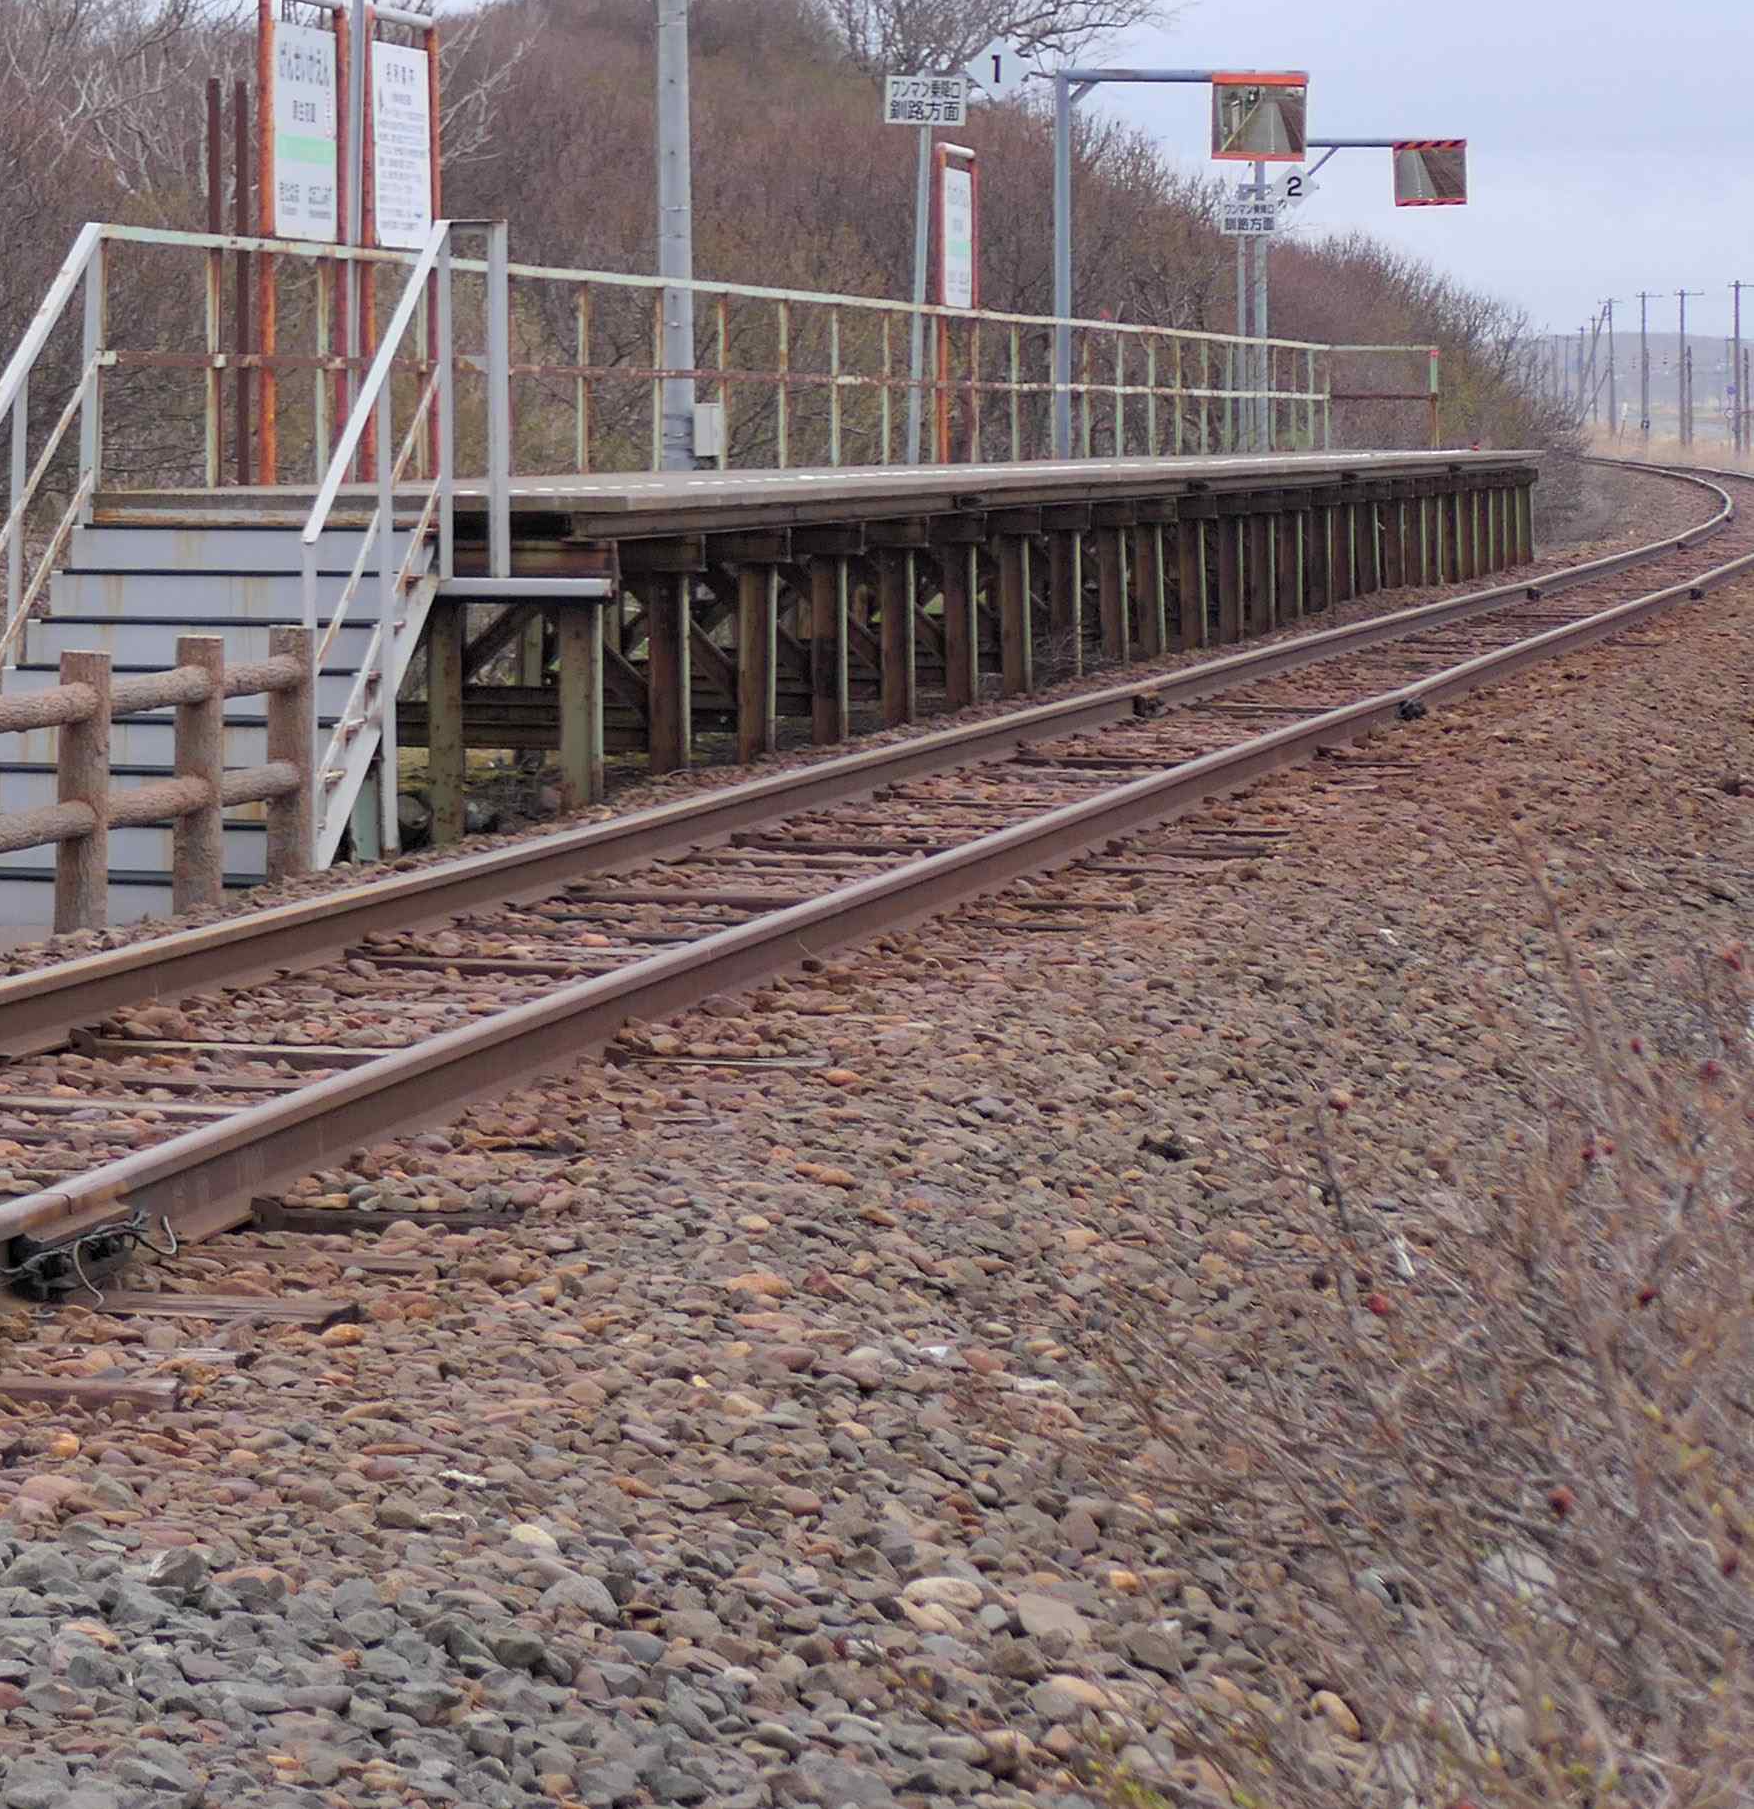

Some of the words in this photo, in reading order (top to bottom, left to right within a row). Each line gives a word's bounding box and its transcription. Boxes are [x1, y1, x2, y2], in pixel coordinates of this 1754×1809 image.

[990, 54, 1002, 84] 1
[892, 80, 961, 98] ワンマン乗降口
[890, 99, 960, 121] 釧路方面
[1287, 176, 1303, 197] 2
